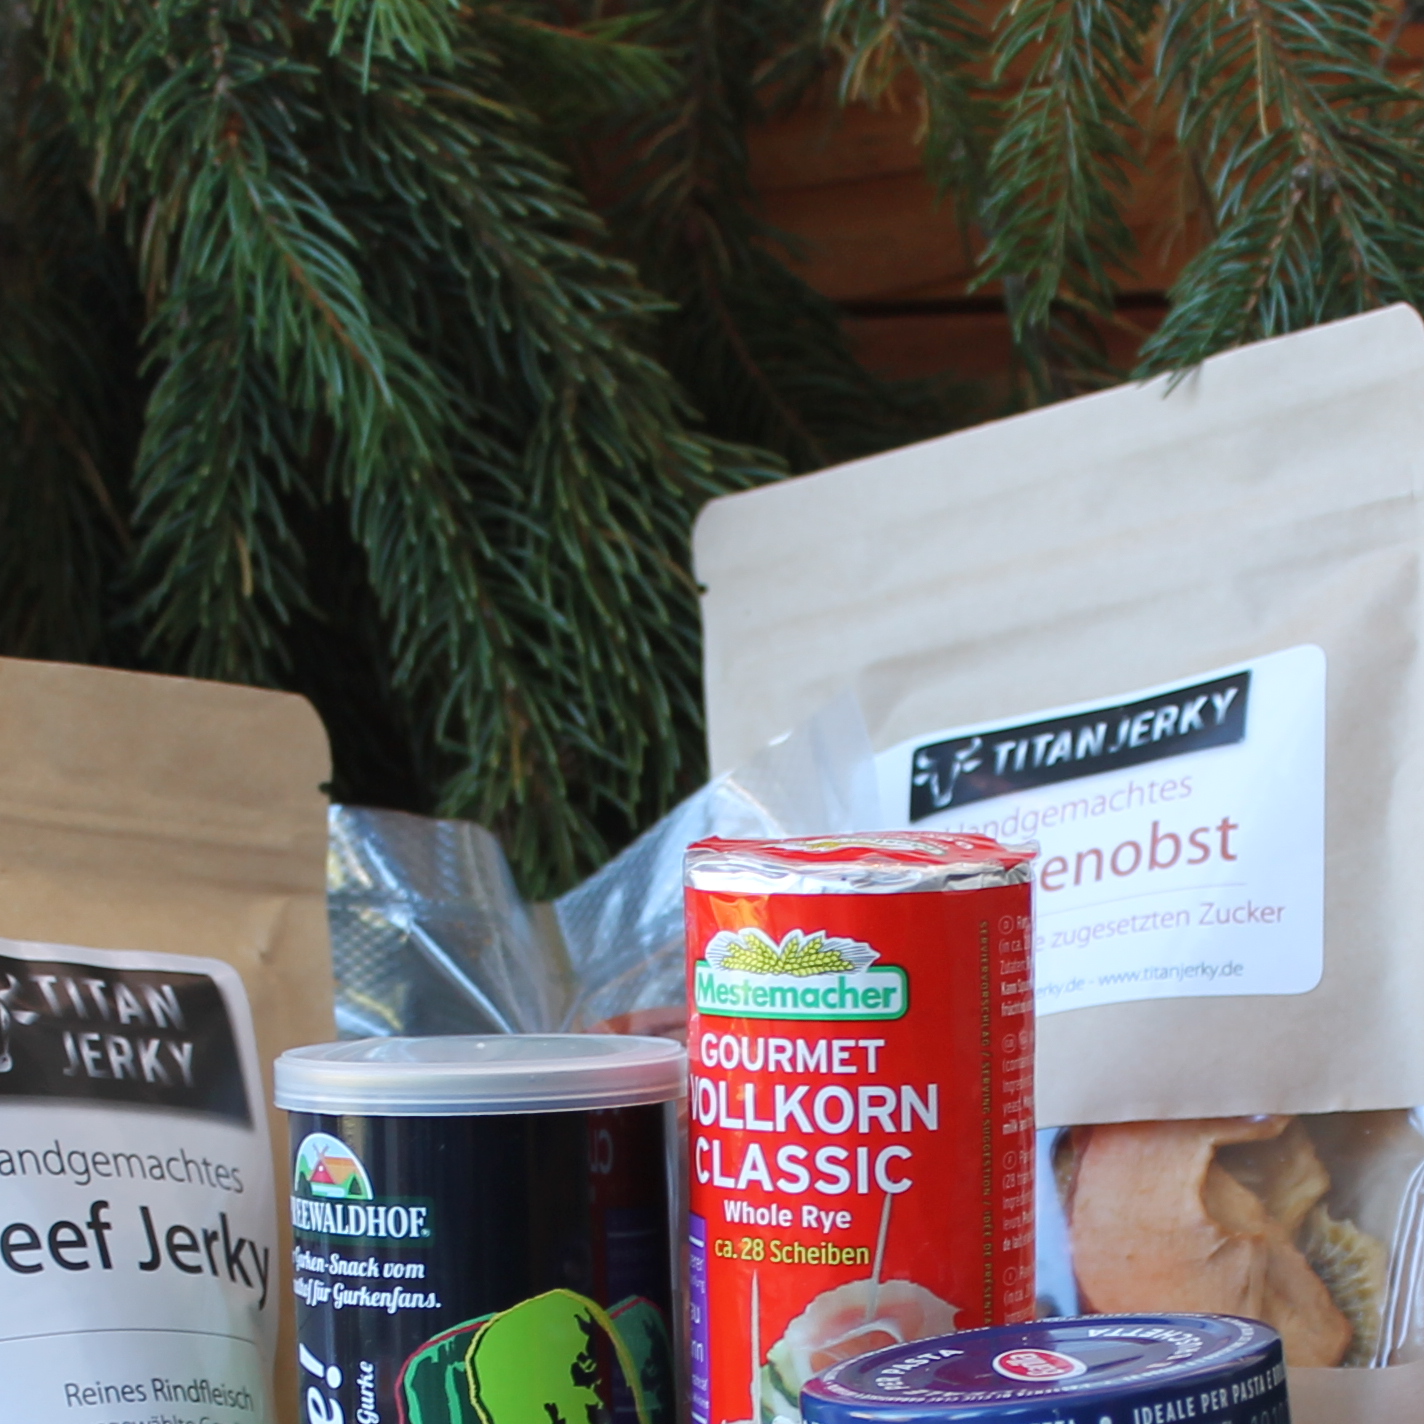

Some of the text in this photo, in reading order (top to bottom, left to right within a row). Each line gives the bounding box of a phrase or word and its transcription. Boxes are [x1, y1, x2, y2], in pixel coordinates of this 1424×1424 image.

[993, 687, 1239, 775] TITAN JERKY
[945, 776, 1192, 840] ndgemachtes
[1051, 909, 1190, 948] zugesetzten
[1199, 901, 1286, 926] Zucker
[697, 971, 897, 1010] Mestemacher
[1098, 961, 1244, 987] www.titanjerky.de
[31, 974, 185, 1029] TITAN
[63, 1032, 193, 1087] JERKY
[701, 1033, 885, 1074] GOURMET
[690, 1073, 939, 1134] VOLLKORN
[695, 1136, 913, 1195] CLASSIC
[724, 1199, 852, 1234] Whole Rye
[138, 1205, 270, 1310] Jerky
[383, 1263, 425, 1278] vom
[714, 1237, 870, 1265] ca. 28 Scheiben
[333, 1283, 441, 1314] Gurkenfans.
[64, 1378, 254, 1412] Reines Rindfleisch
[1201, 1388, 1228, 1413] PER
[1232, 1375, 1266, 1404] PASTA
